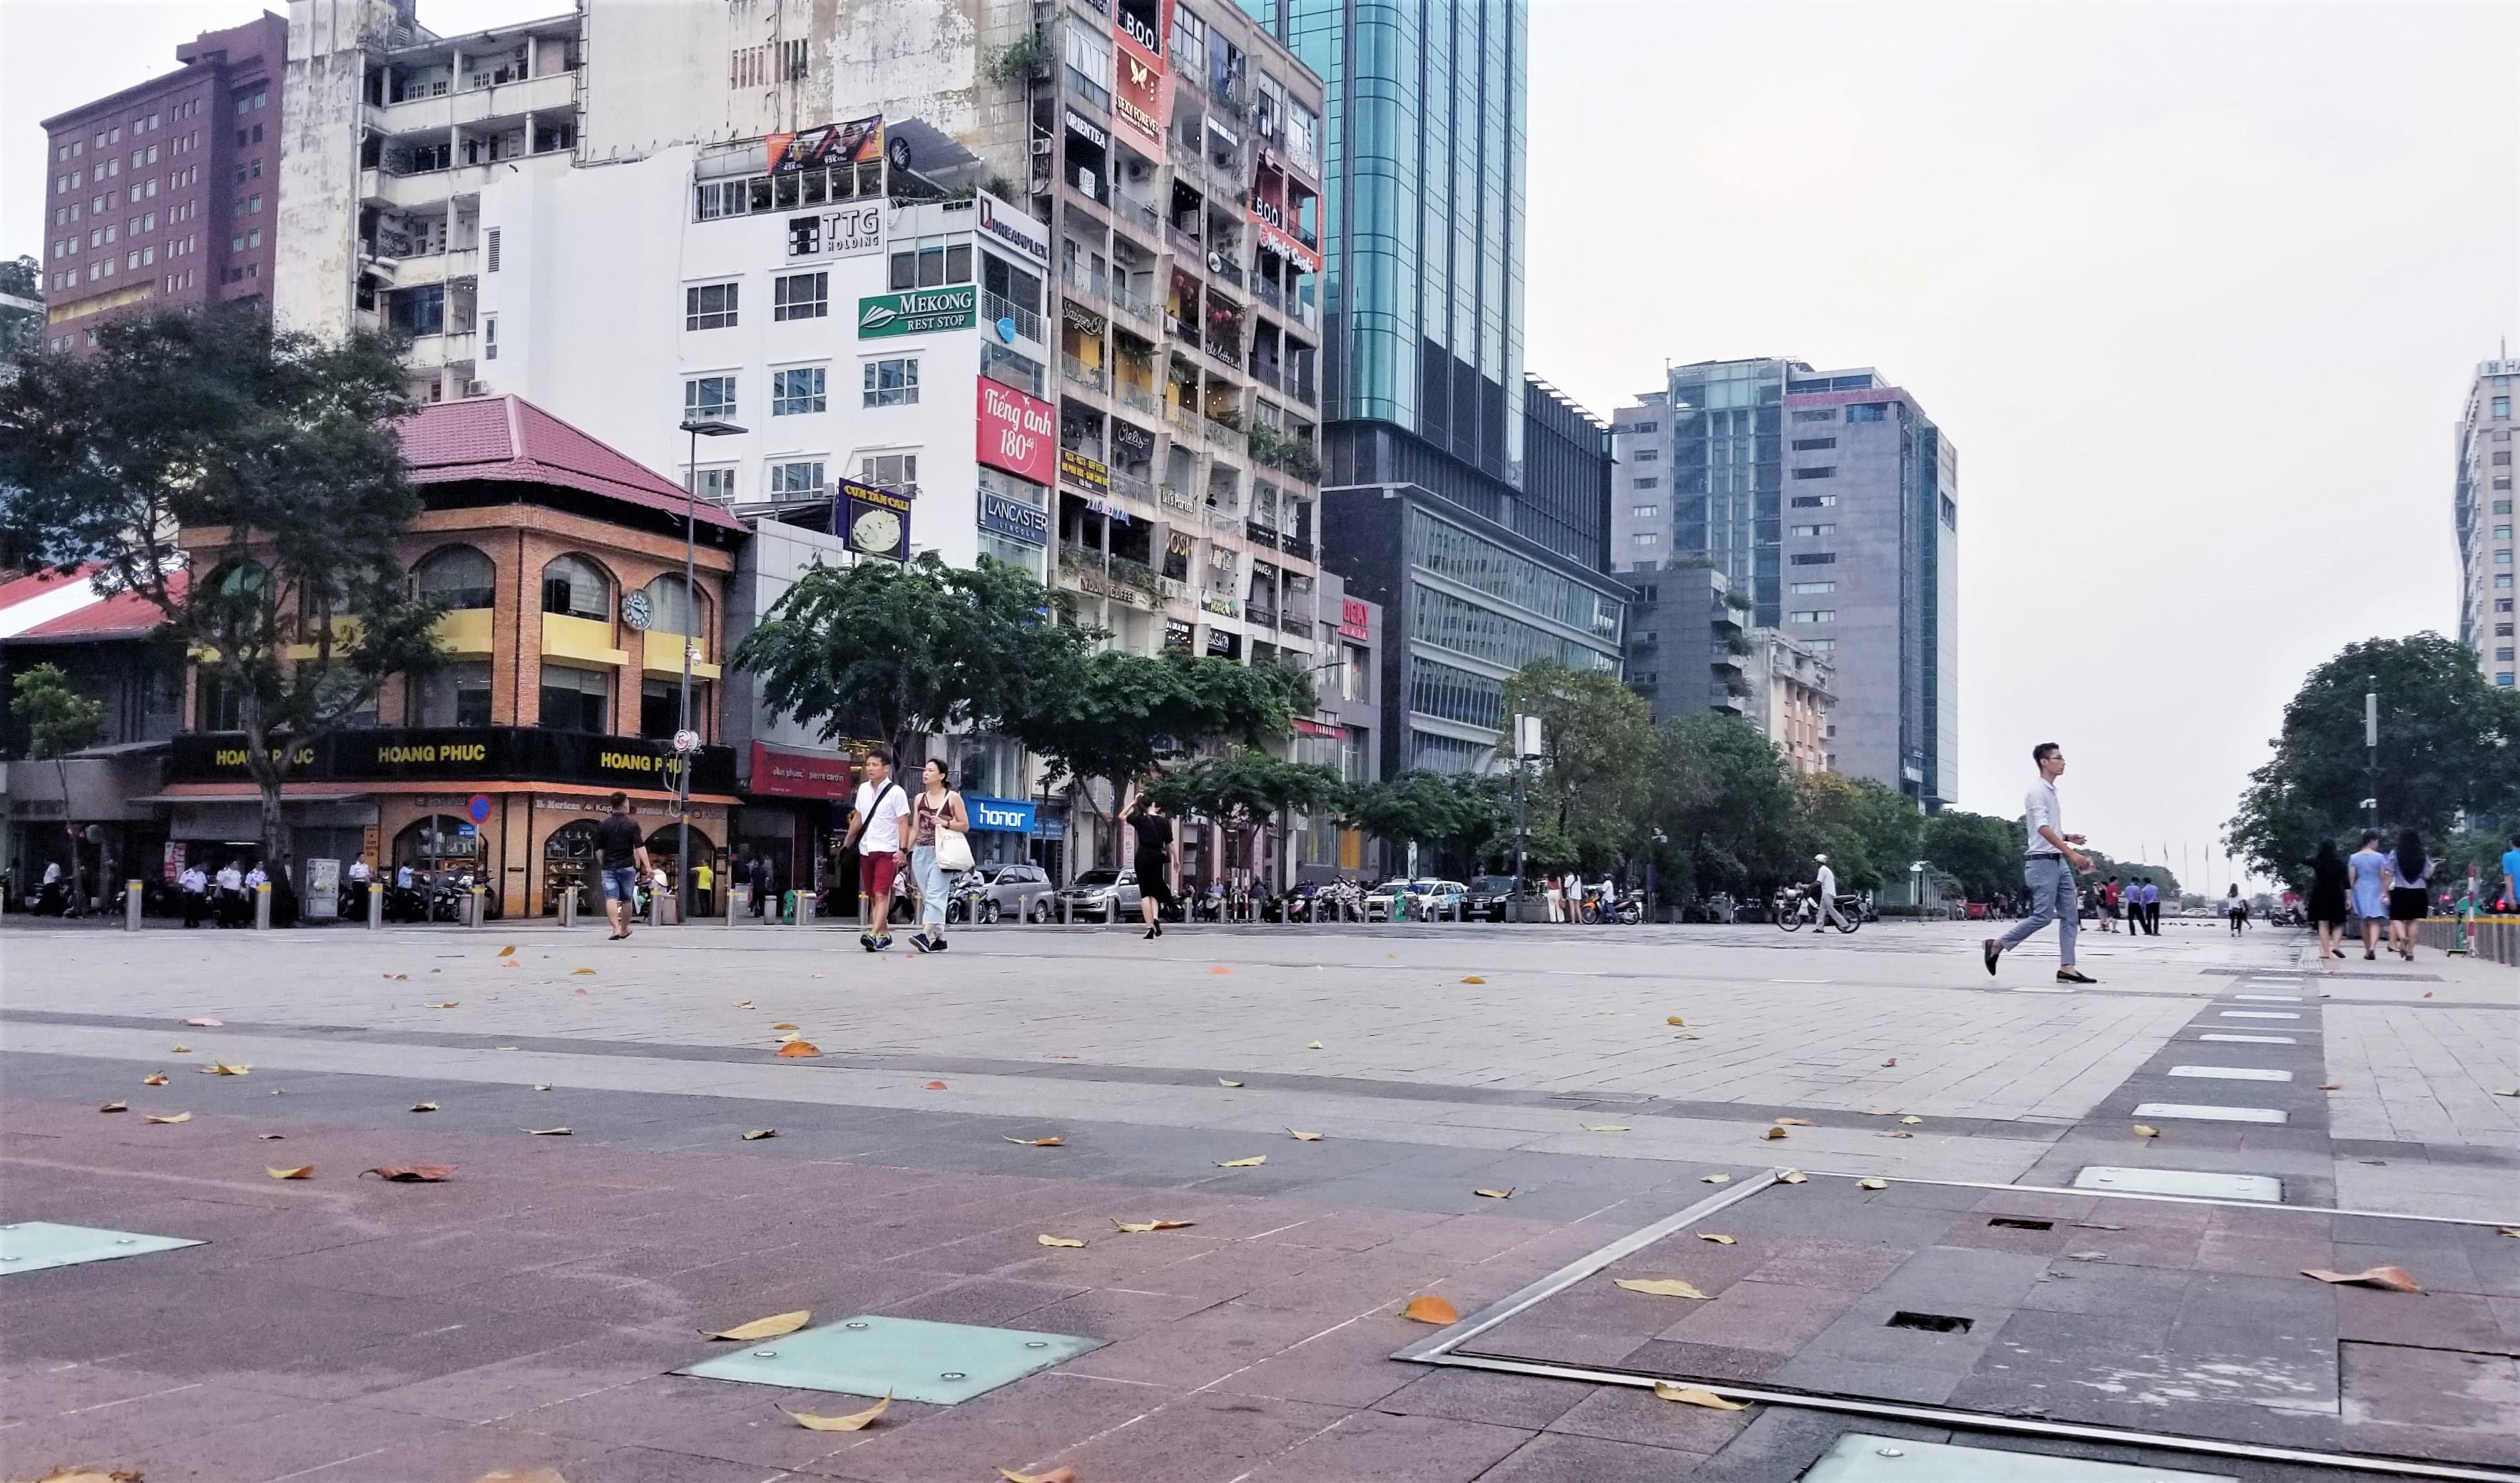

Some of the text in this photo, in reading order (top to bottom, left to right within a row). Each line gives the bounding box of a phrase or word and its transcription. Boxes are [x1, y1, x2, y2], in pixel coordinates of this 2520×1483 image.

[1126, 11, 1154, 51] BOO
[1118, 96, 1133, 116] SEXY
[1066, 111, 1106, 149] ORIENTEA
[822, 208, 879, 239] TTG
[1256, 197, 1279, 228] BOO
[827, 235, 879, 253] HOLDING
[992, 219, 1048, 260] DREAMPLEX
[899, 290, 973, 315] MEKONG
[907, 313, 965, 332] REST STOP
[984, 388, 1021, 426] Tiếng
[999, 428, 1026, 461] 180
[987, 499, 1048, 532] LANCASTER
[999, 522, 1035, 539] LINCOLN
[272, 748, 314, 765] PUC
[378, 744, 486, 763] HOANG PHUC
[601, 752, 683, 774] HOANG PHU
[979, 802, 1026, 827] honor
